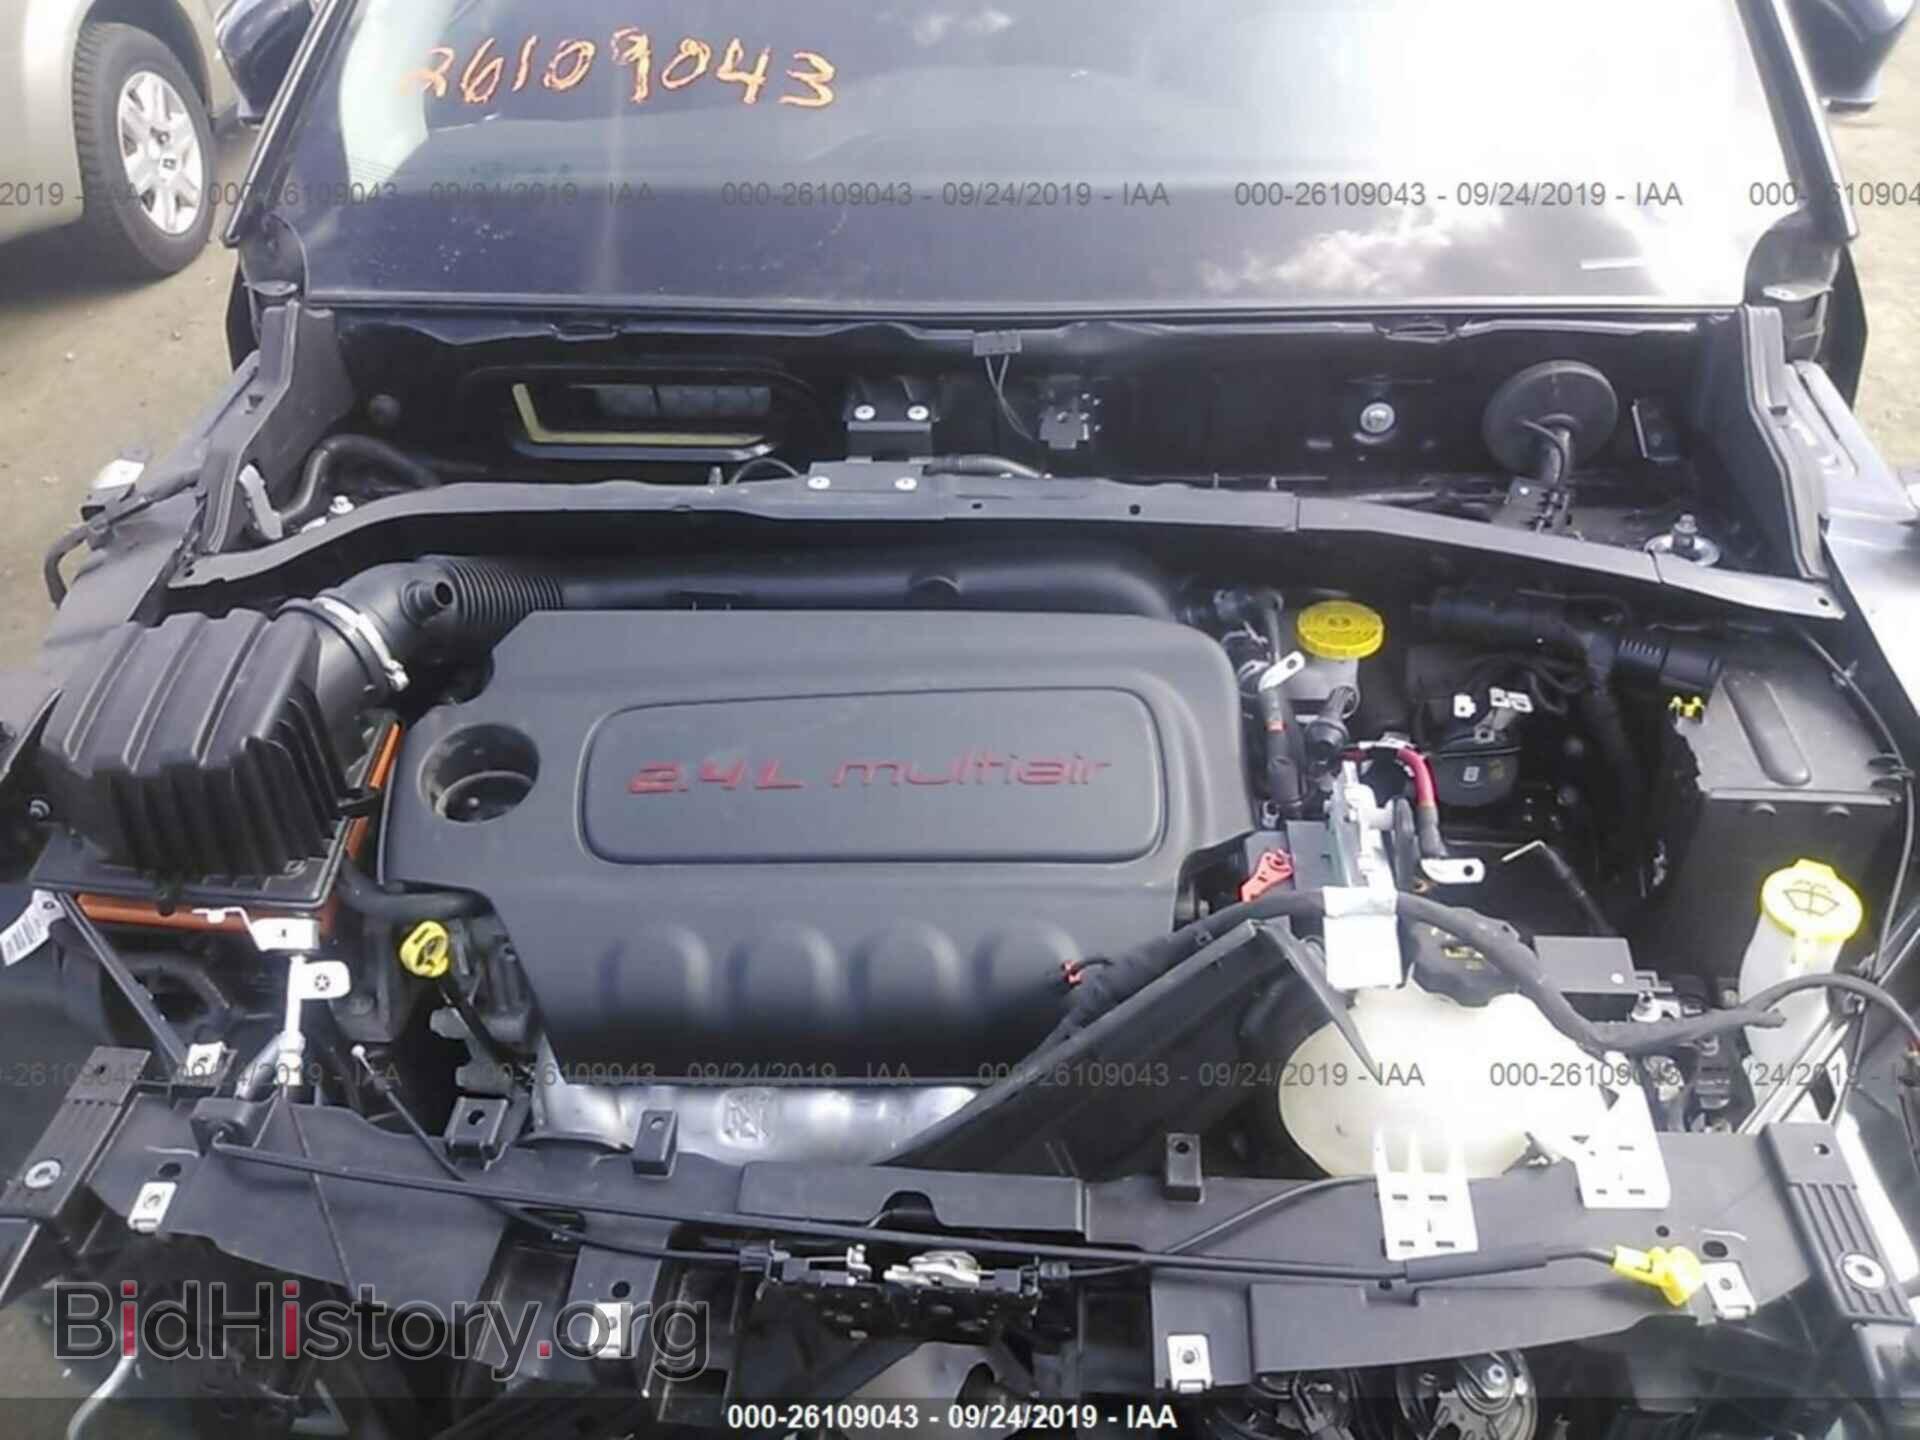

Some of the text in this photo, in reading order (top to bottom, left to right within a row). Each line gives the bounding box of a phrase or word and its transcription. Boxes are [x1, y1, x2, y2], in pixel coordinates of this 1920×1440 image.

[402, 27, 834, 106] 26109043
[627, 752, 1112, 794] 2.4L multiair
